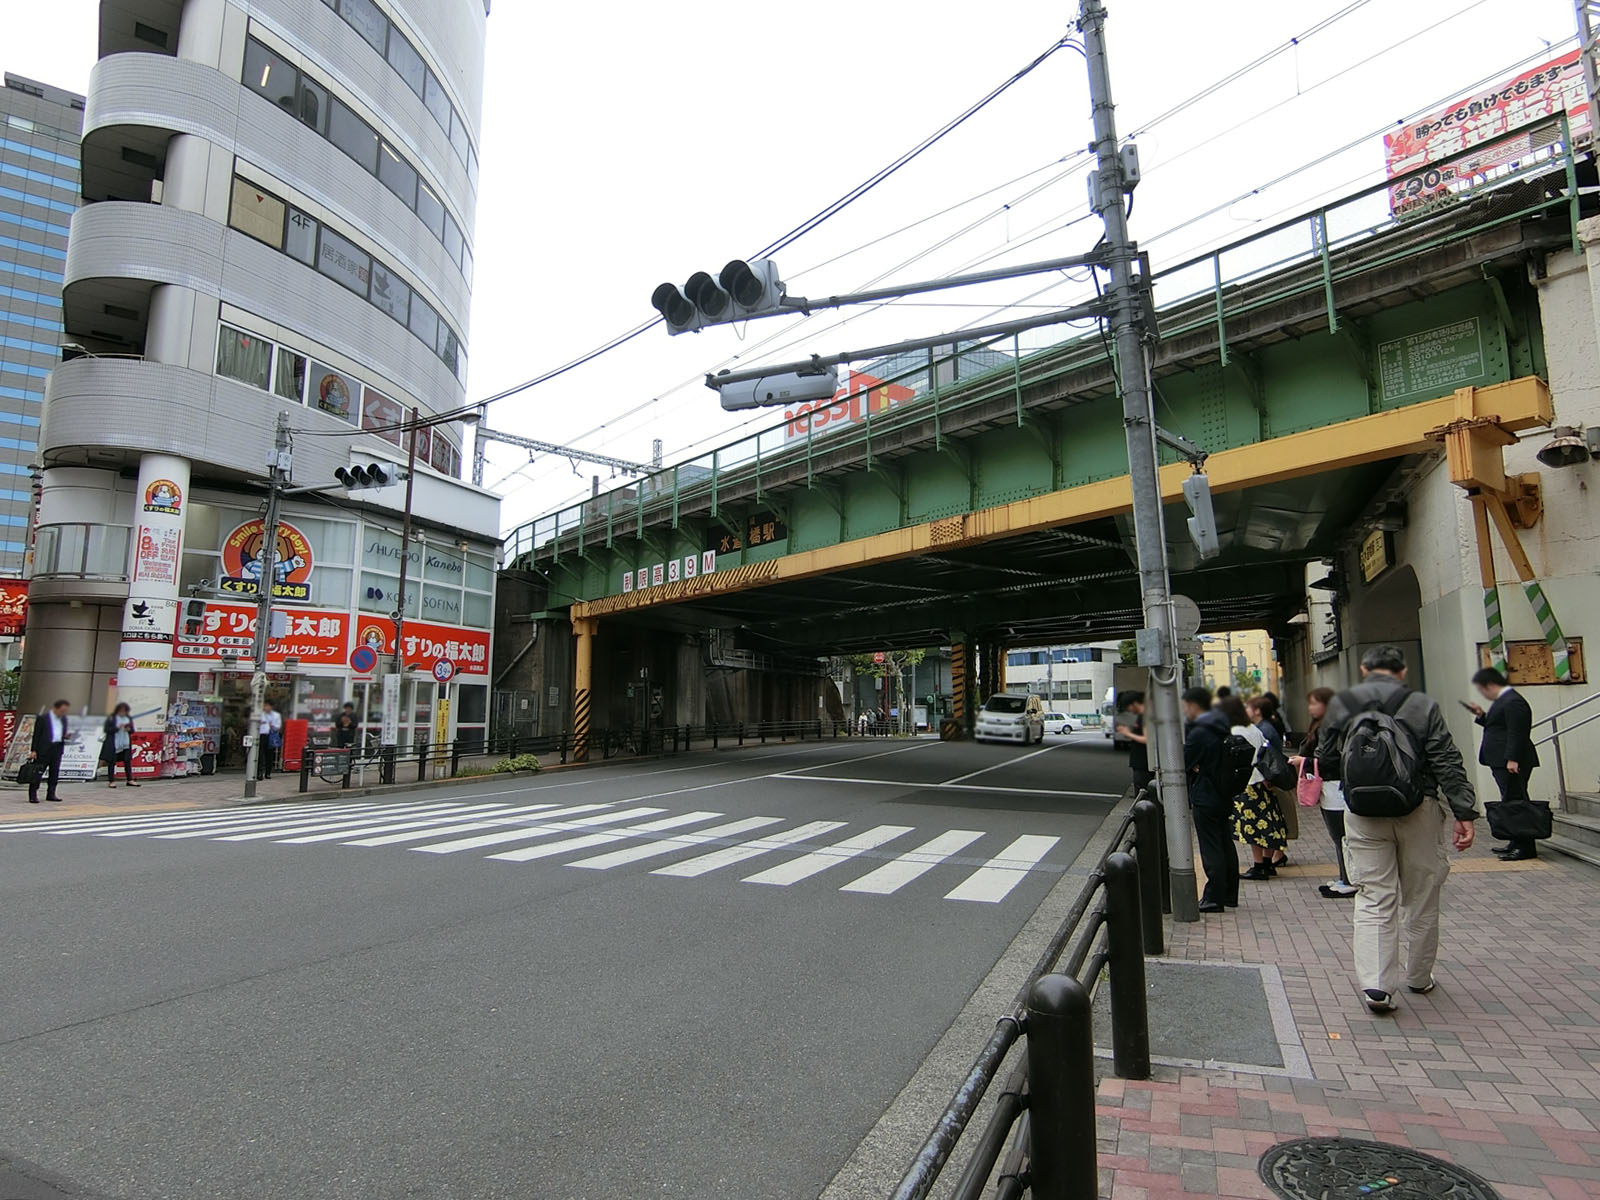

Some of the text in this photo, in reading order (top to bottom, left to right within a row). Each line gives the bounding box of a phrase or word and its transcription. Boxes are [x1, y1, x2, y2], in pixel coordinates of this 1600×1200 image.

[291, 212, 311, 230] 4F
[230, 523, 309, 555] Smile ery day!
[366, 542, 420, 562] SHISEDO
[426, 555, 462, 573] Kanebo
[222, 580, 307, 597] くすり福太郎
[423, 597, 460, 613] SOFINA
[204, 609, 341, 638] すり太郎
[182, 646, 210, 654] 日用品
[267, 643, 338, 656] ツルハグループ
